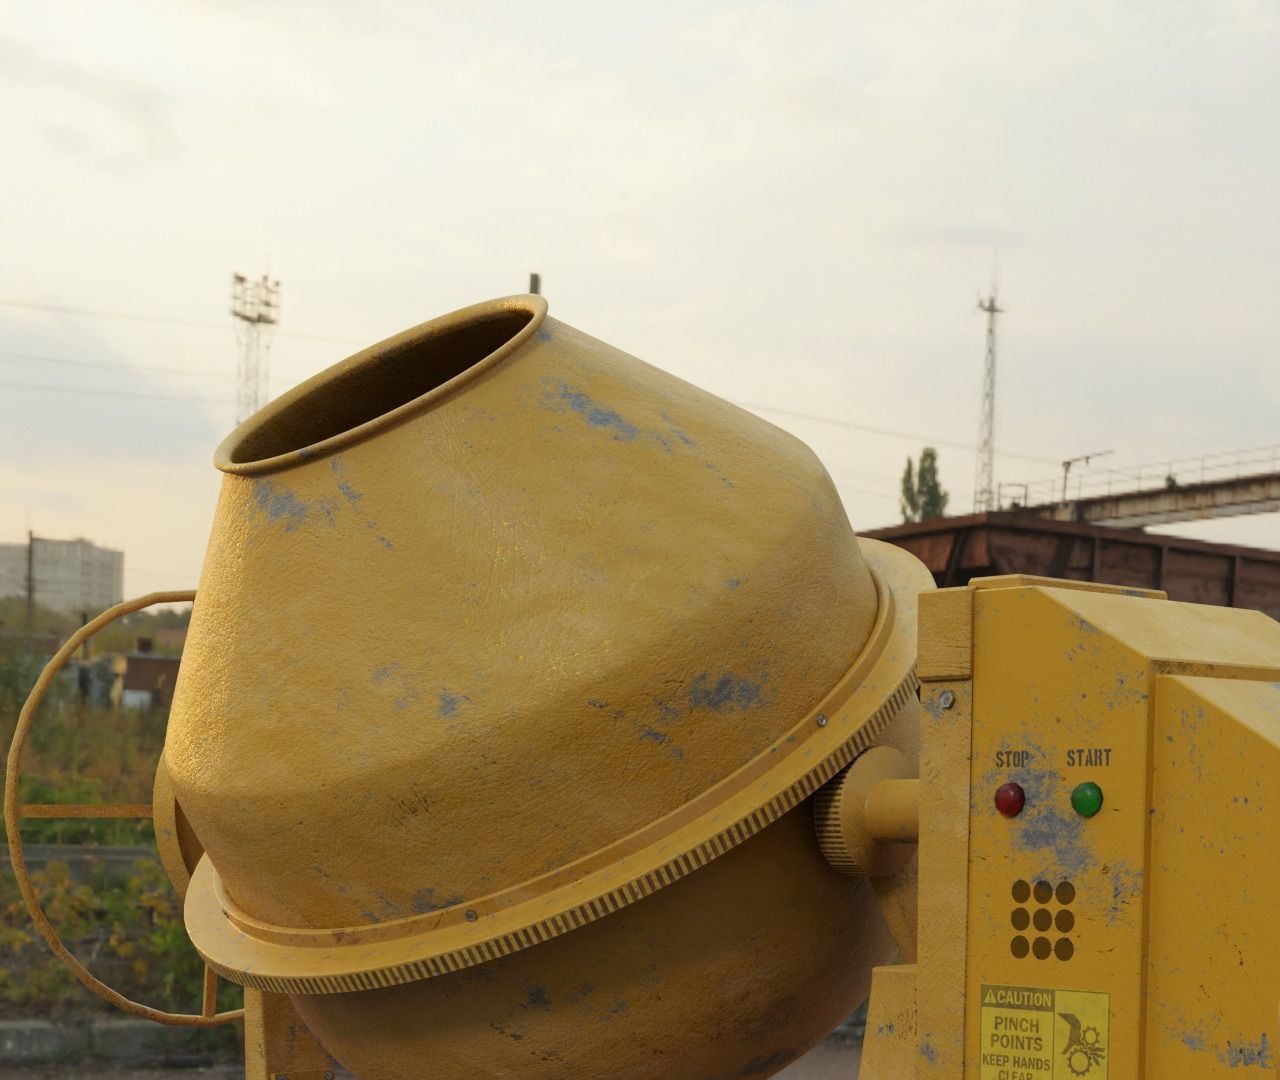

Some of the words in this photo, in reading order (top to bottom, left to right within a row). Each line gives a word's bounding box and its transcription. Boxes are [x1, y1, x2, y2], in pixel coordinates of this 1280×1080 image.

[995, 751, 1029, 768] STOP
[1067, 749, 1112, 767] START
[997, 990, 1051, 1007] CAUTION
[994, 1016, 1040, 1033] PINCH
[990, 1034, 1043, 1051] POINTS
[982, 1053, 1009, 1067] KEEP
[1013, 1056, 1050, 1071] HANDS
